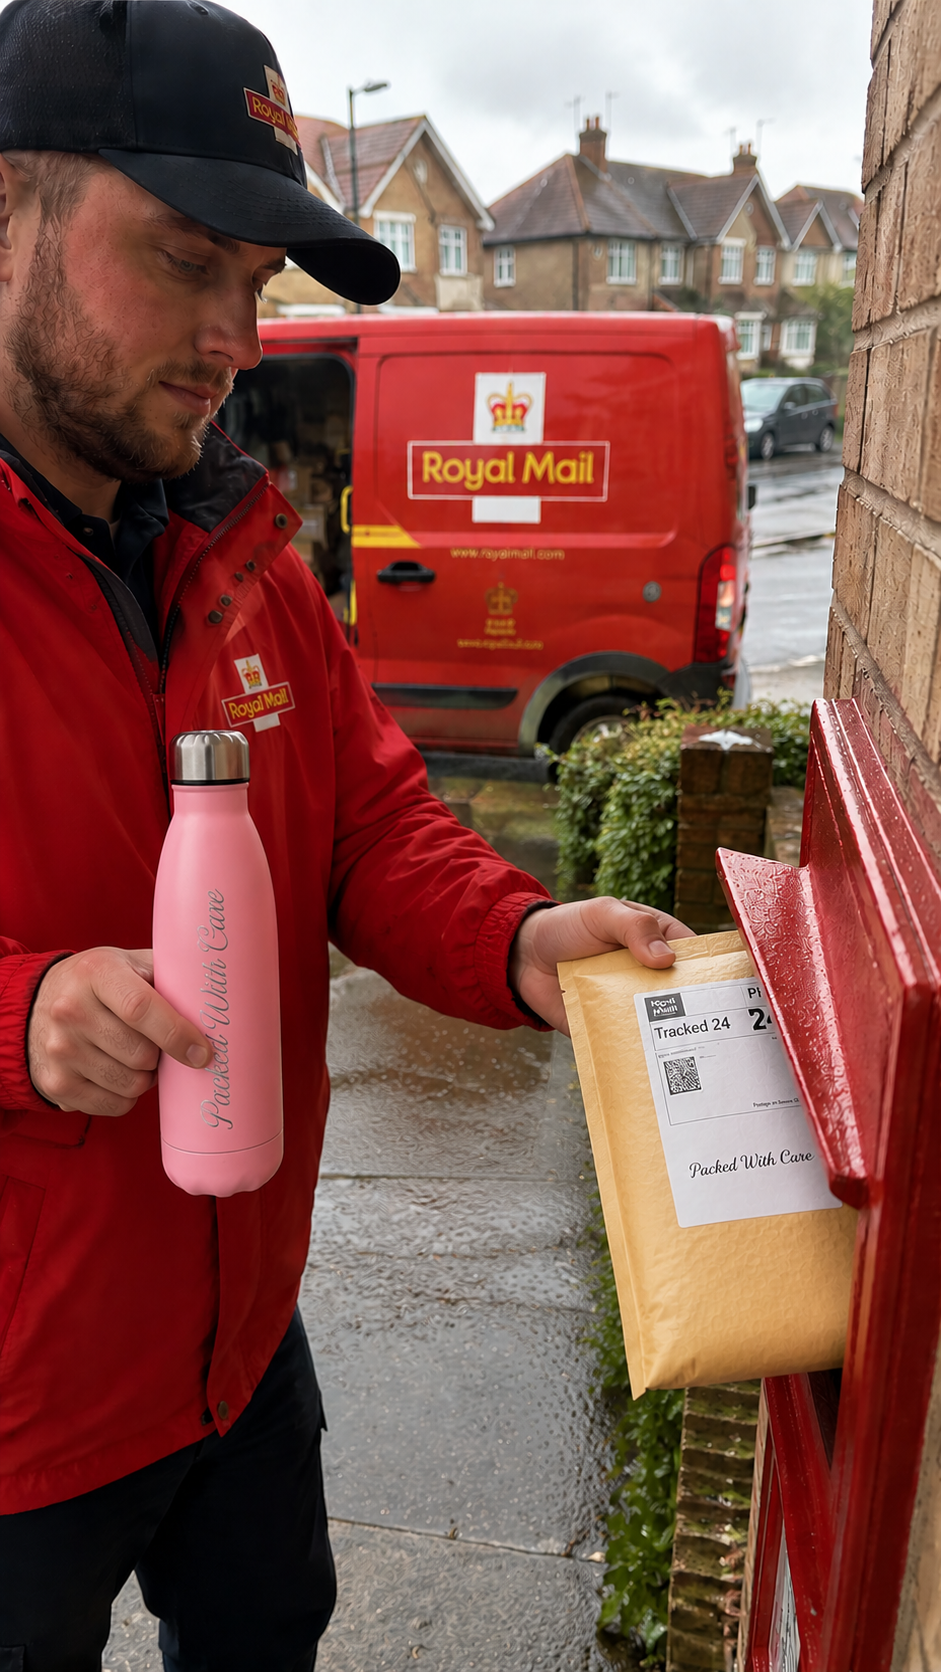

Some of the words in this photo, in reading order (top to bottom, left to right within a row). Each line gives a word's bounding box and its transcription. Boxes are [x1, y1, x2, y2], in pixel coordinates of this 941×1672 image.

[252, 96, 286, 126] Royal
[422, 451, 515, 491] Royal
[521, 451, 594, 484] Mail
[228, 695, 264, 719] Royal
[263, 687, 289, 709] Mail
[196, 888, 229, 953] Care
[200, 957, 231, 1030] With
[654, 1019, 709, 1039] Tracked
[711, 1016, 731, 1031] 24
[200, 1033, 234, 1130] Packed
[689, 1157, 738, 1178] Packed
[740, 1151, 777, 1169] With
[780, 1149, 815, 1164] Care
